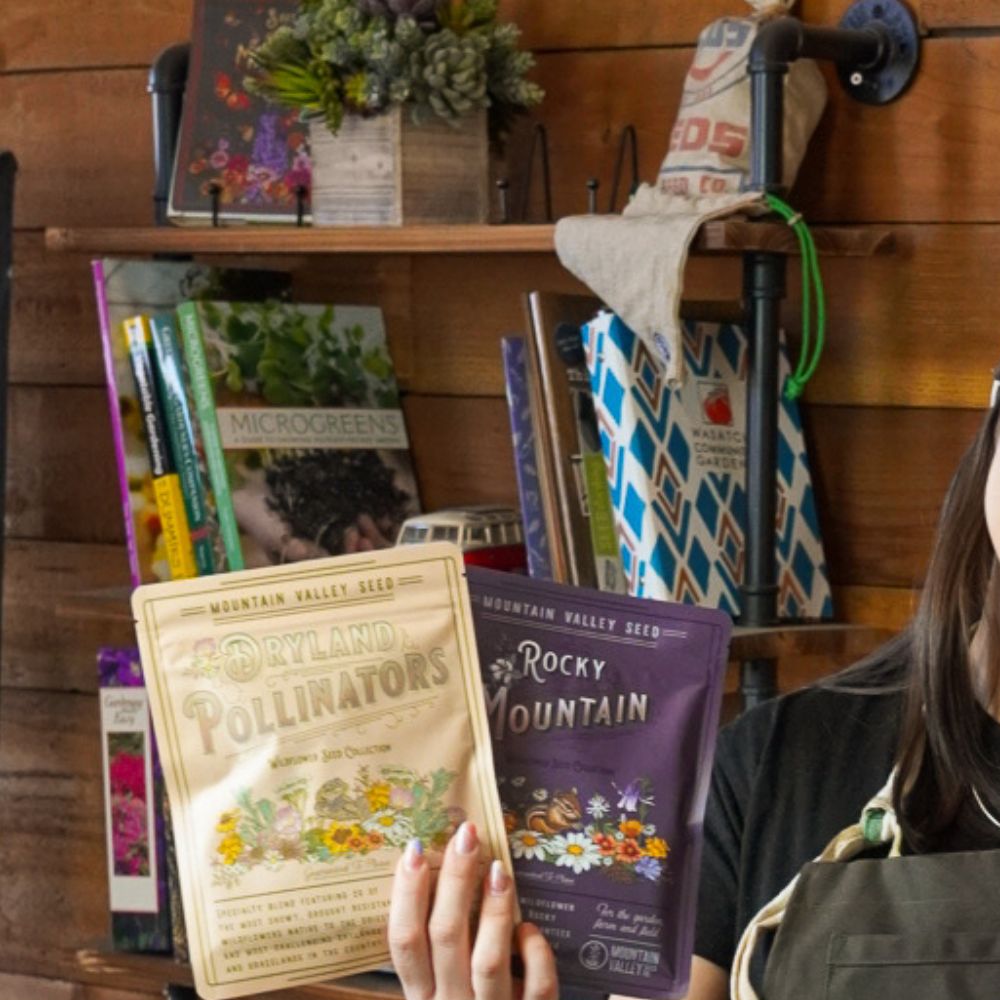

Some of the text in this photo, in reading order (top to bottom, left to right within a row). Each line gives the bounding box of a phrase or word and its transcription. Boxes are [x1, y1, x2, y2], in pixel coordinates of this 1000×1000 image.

[145, 412, 164, 476] Gardening
[230, 413, 399, 435] MICROGREENS
[209, 577, 394, 615] MOUNTAIN VALLEY SEED
[483, 596, 660, 639] MOUNTAIN VALLEY SEED
[219, 619, 397, 683] DRYLAND
[518, 640, 606, 684] ROCKY
[181, 647, 450, 756] POLLINATORS
[485, 687, 648, 741] MOUNTAIN
